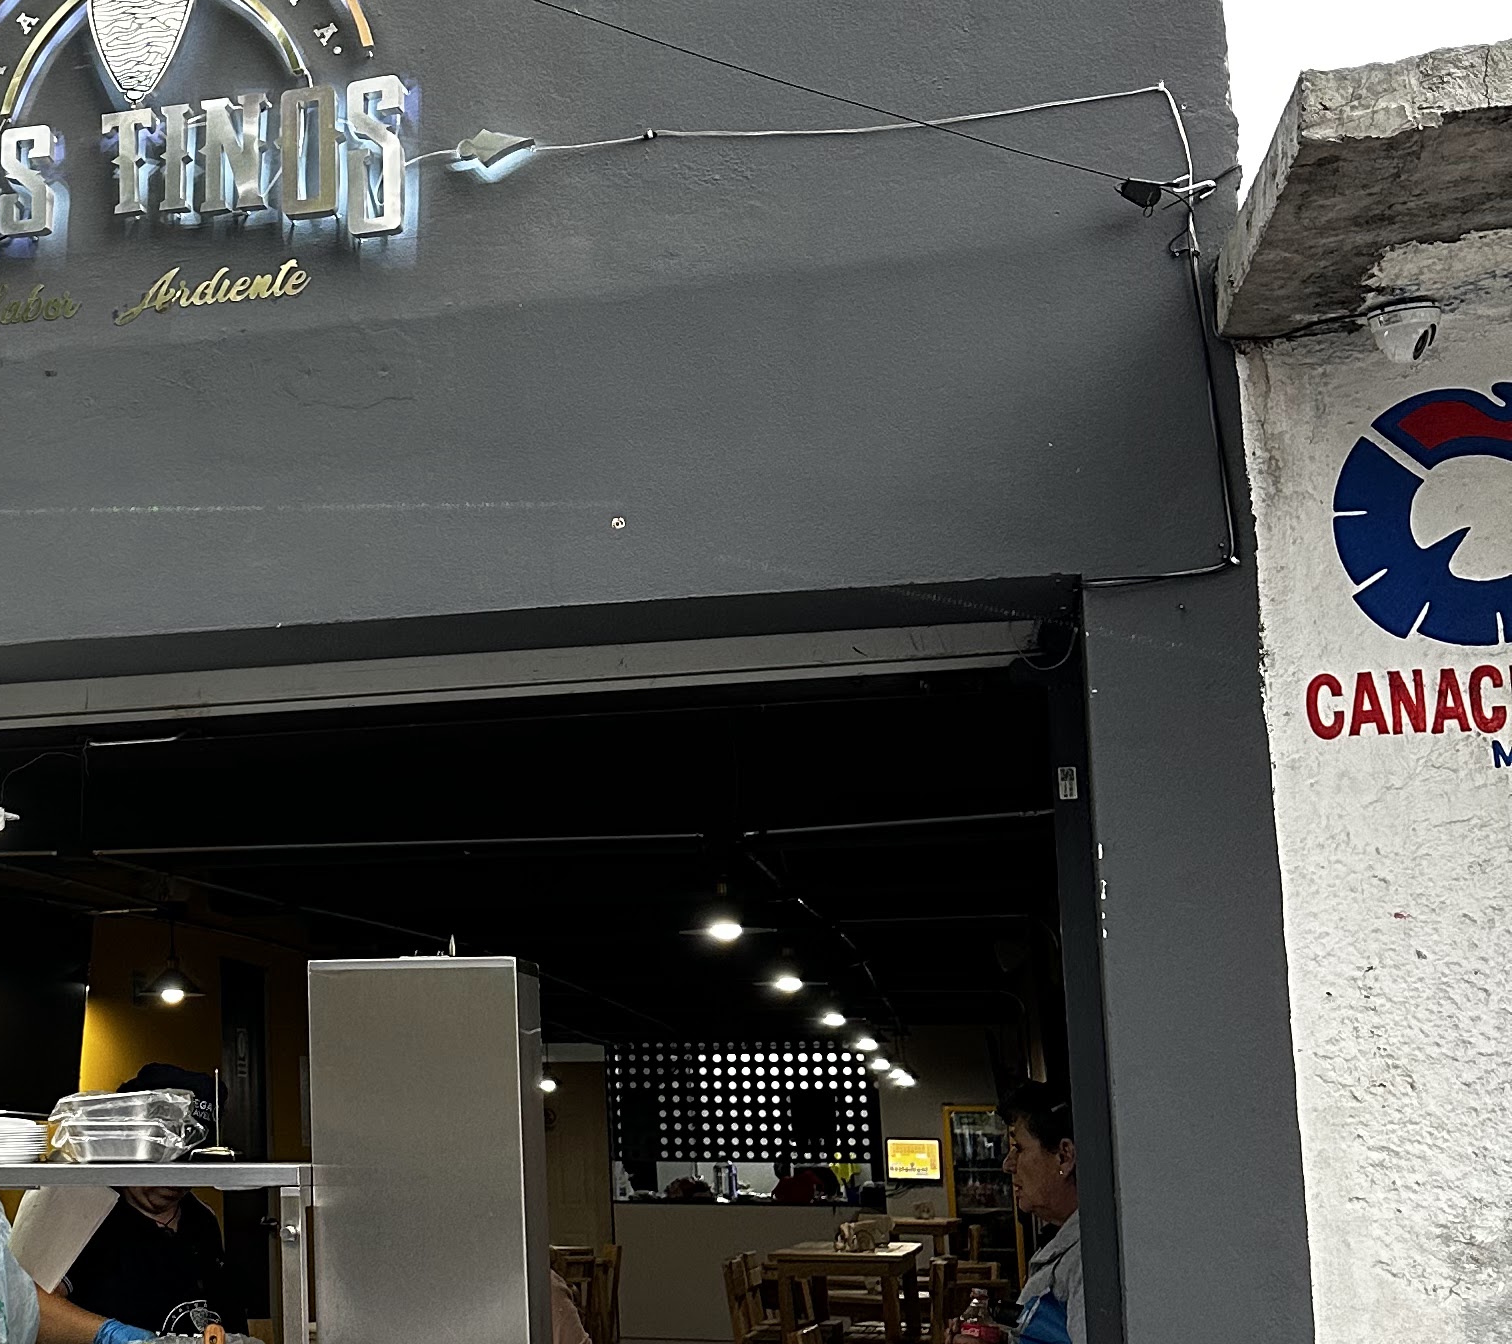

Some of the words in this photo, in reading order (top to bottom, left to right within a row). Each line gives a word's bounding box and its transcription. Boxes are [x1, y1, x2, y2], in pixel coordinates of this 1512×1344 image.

[101, 73, 412, 239] TINOS
[114, 258, 312, 326] Ardiente
[1306, 664, 1512, 740] CANAC
